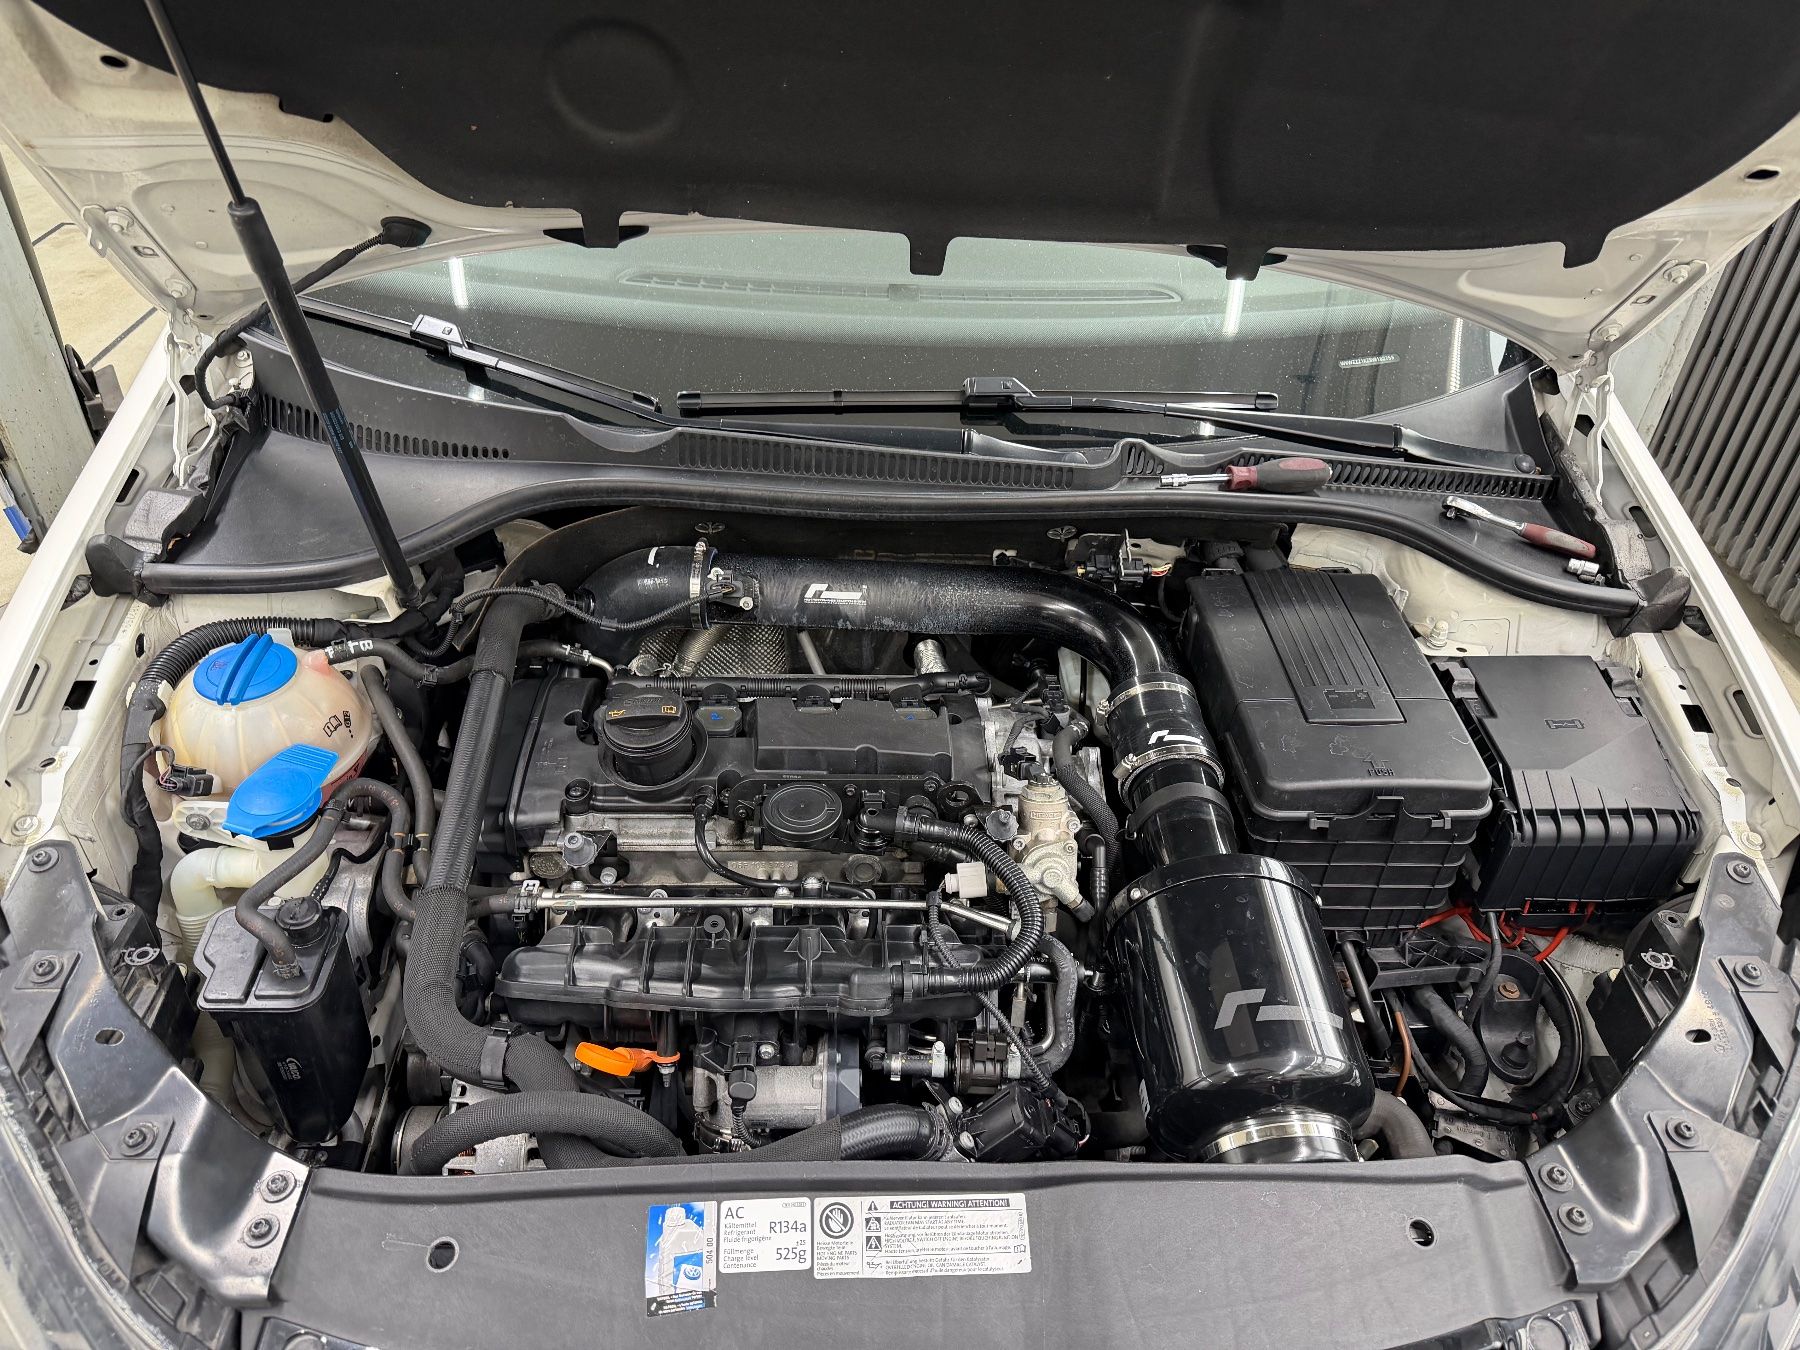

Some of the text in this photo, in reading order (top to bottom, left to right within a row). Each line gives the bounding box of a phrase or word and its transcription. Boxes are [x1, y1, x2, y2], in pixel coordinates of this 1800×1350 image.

[1367, 768, 1396, 777] PUSH
[892, 1199, 1008, 1209] ACHTUNG! WARNING! ATTENTION!
[724, 1206, 745, 1219] AC
[724, 1221, 757, 1229] Kältemittel
[769, 1220, 807, 1234] R134a
[706, 1237, 714, 1265] 504 00
[776, 1247, 807, 1264] 525g
